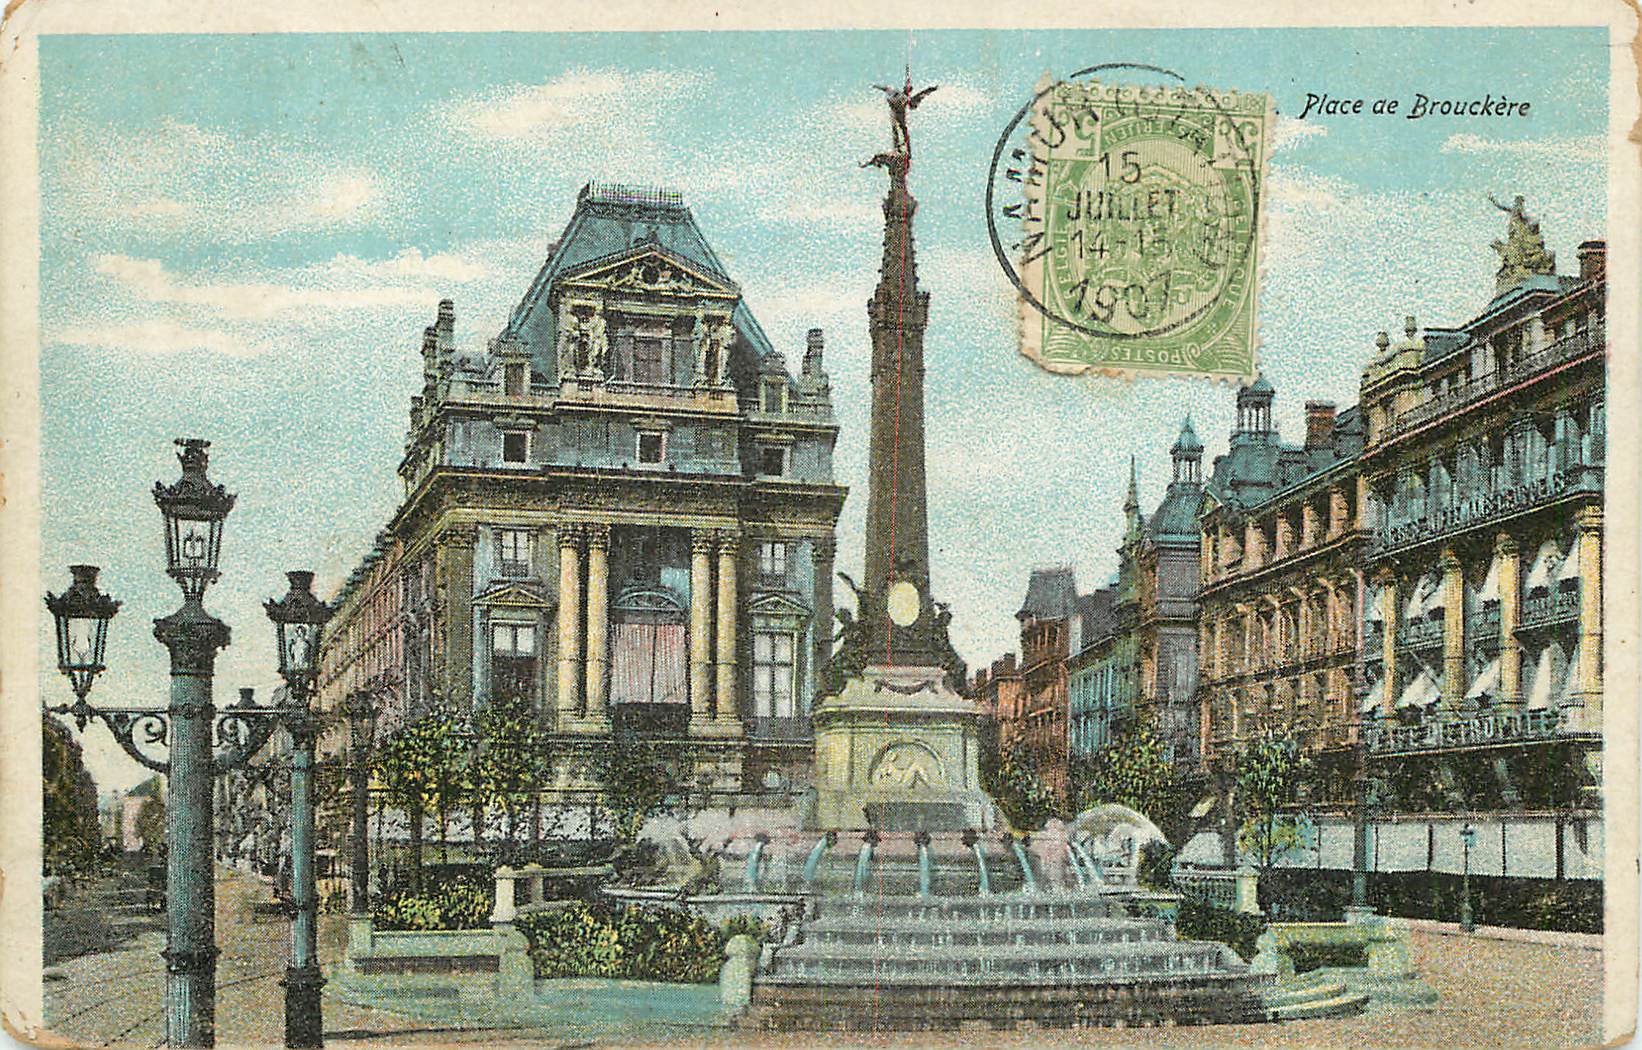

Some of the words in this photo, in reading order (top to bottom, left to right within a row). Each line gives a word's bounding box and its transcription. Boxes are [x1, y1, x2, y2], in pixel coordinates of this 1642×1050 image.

[1099, 151, 1142, 184] 15
[1067, 190, 1180, 221] JUILLET
[1069, 271, 1172, 323] 1907
[1111, 346, 1182, 364] POSTES
